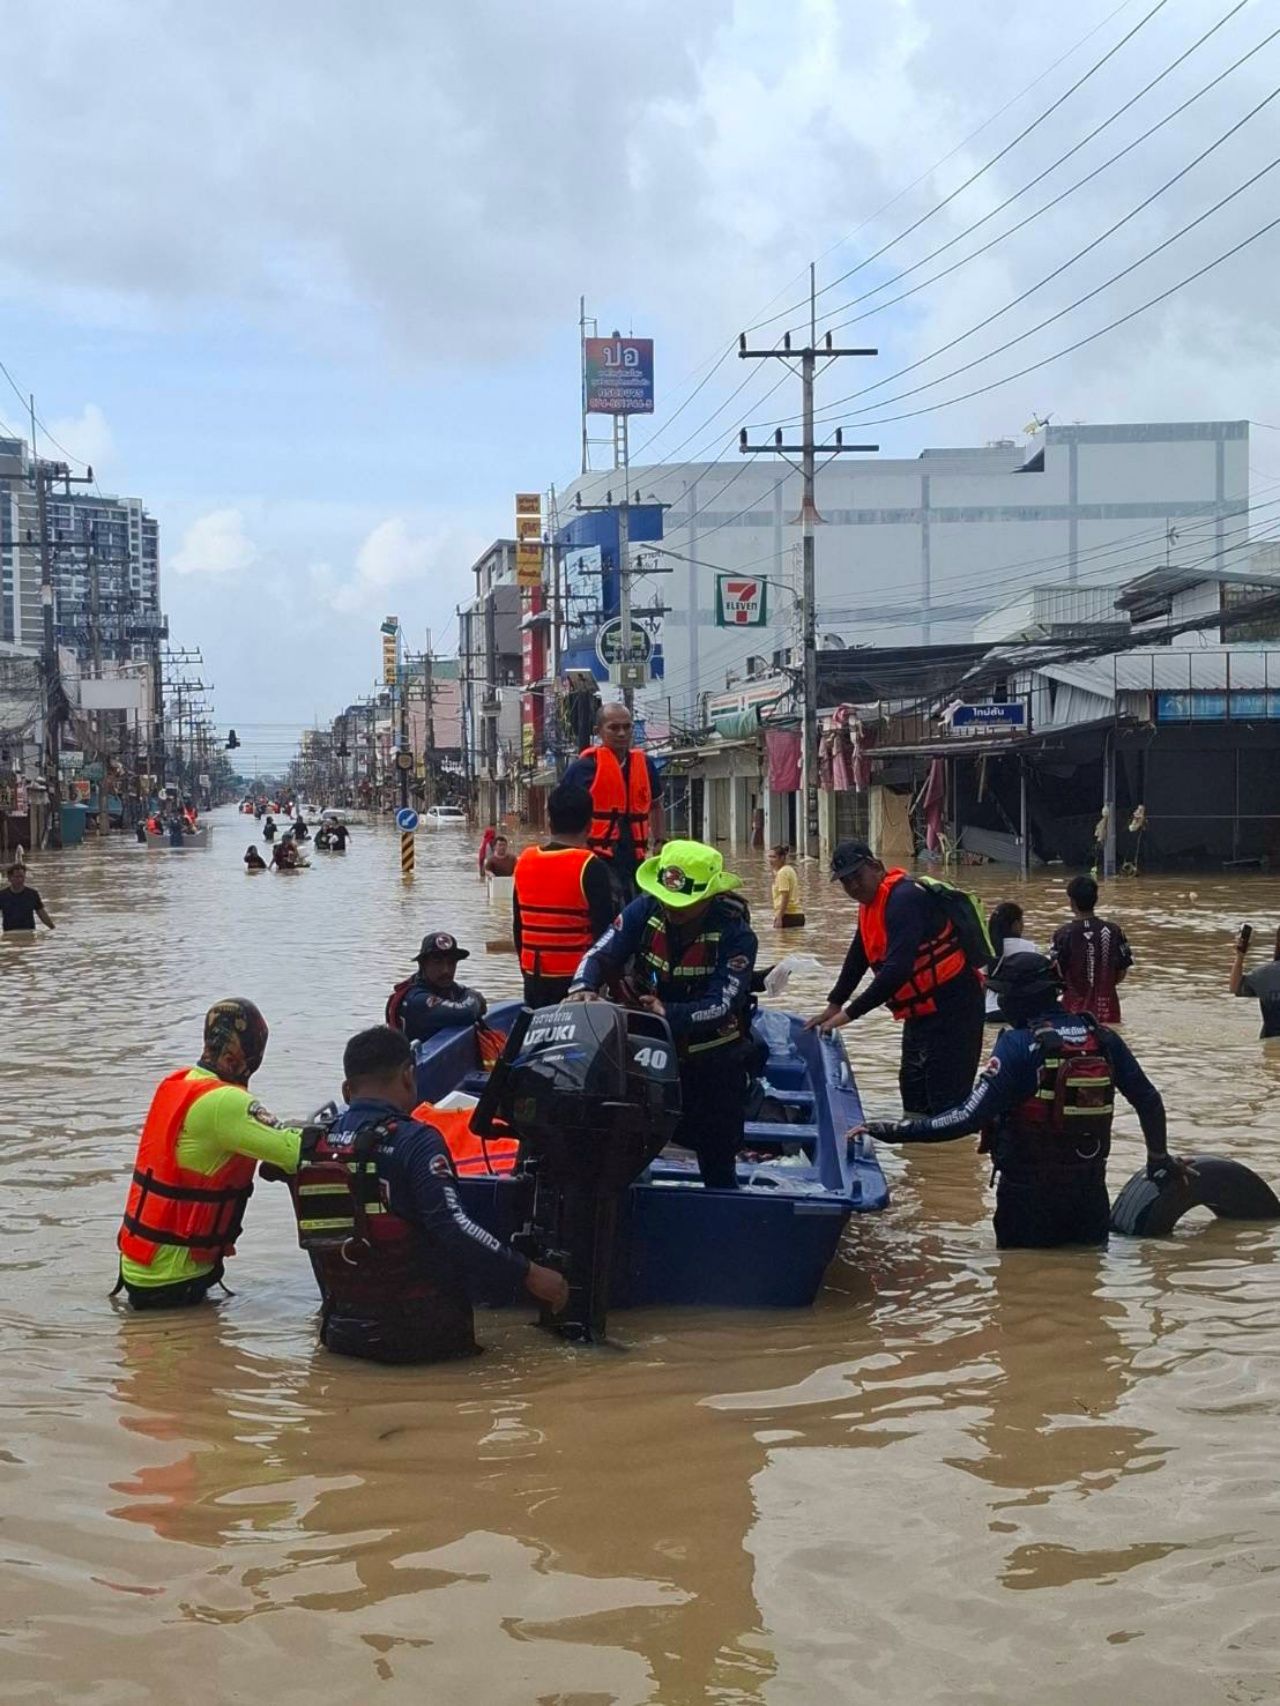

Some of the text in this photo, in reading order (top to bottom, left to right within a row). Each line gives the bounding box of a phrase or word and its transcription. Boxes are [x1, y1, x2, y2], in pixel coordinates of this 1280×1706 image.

[727, 582, 757, 622] 7
[523, 1025, 577, 1047] UZUKI
[633, 1047, 668, 1069] 40
